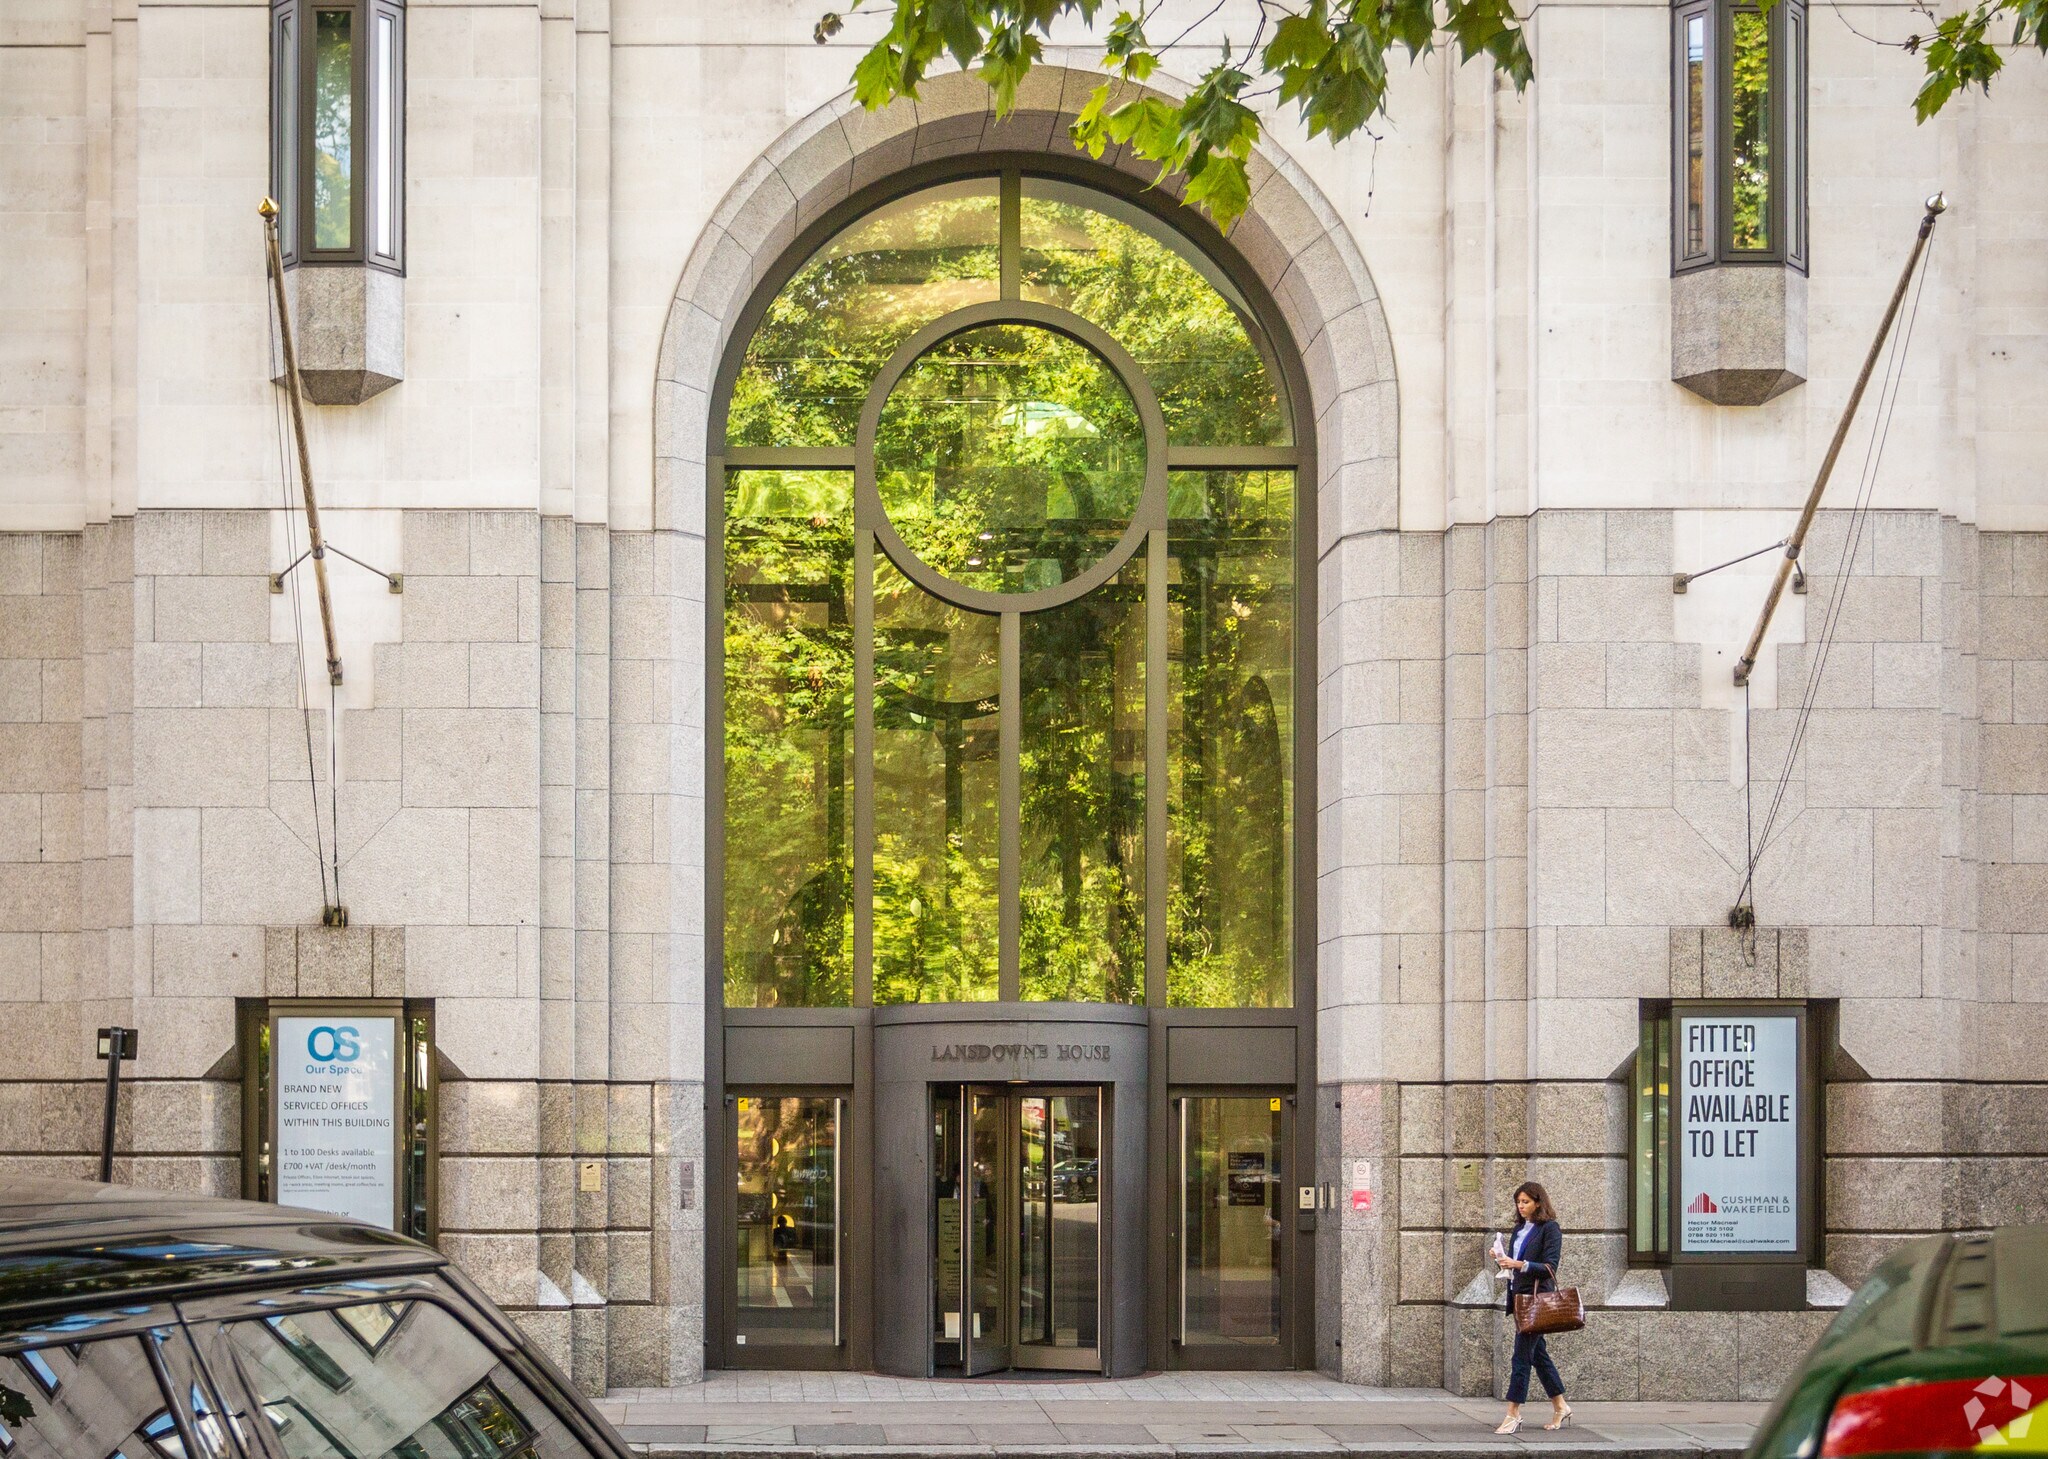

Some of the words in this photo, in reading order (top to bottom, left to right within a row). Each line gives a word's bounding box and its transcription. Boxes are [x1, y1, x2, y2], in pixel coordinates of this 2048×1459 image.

[1689, 1024, 1756, 1053] FITTED
[307, 1025, 361, 1063] OS
[930, 1044, 1049, 1062] LANSDOWNE
[1057, 1044, 1112, 1062] HOUSE
[305, 1064, 327, 1075] Our
[1689, 1059, 1755, 1088] OFFICE
[284, 1084, 318, 1094] BRAND
[319, 1084, 342, 1094] NEW
[283, 1101, 329, 1111] SERVICED
[330, 1101, 369, 1111] OFFICES
[1688, 1094, 1790, 1123] AVAILABLE
[283, 1118, 320, 1127] WITHIN
[322, 1118, 343, 1127] THIS
[345, 1118, 390, 1127] BUILDING
[1688, 1129, 1715, 1158] TO
[1724, 1129, 1759, 1158] LET
[284, 1148, 288, 1156] 1
[290, 1148, 299, 1156] to
[301, 1148, 315, 1156] 100
[317, 1148, 339, 1156] Desks
[341, 1148, 375, 1156] available
[283, 1162, 303, 1170] £700
[325, 1162, 376, 1172] /desk/month
[1721, 1195, 1779, 1204] CUSHMAN
[1782, 1195, 1790, 1204] &
[1721, 1205, 1790, 1214] WAKEFIELD
